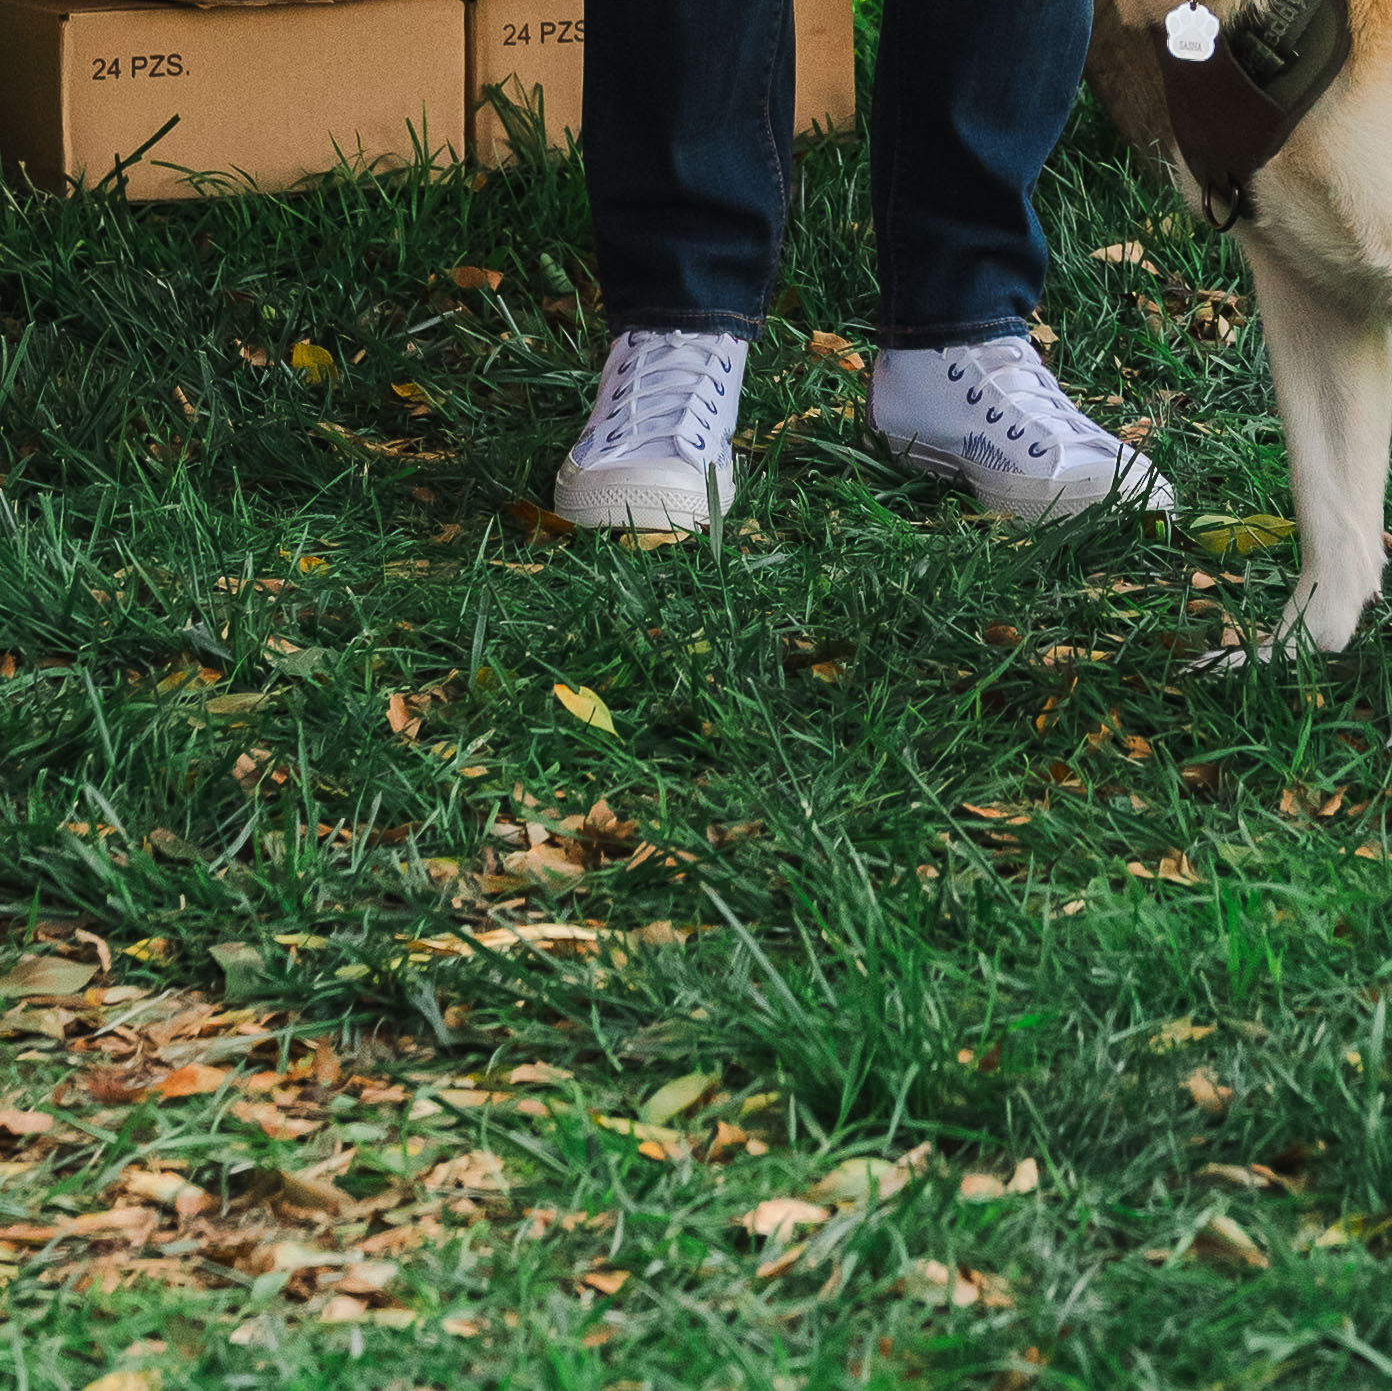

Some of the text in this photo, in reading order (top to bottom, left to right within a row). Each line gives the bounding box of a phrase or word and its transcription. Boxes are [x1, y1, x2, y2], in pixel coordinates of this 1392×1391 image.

[503, 22, 532, 47] 24
[92, 53, 190, 81] 24 PZS.
